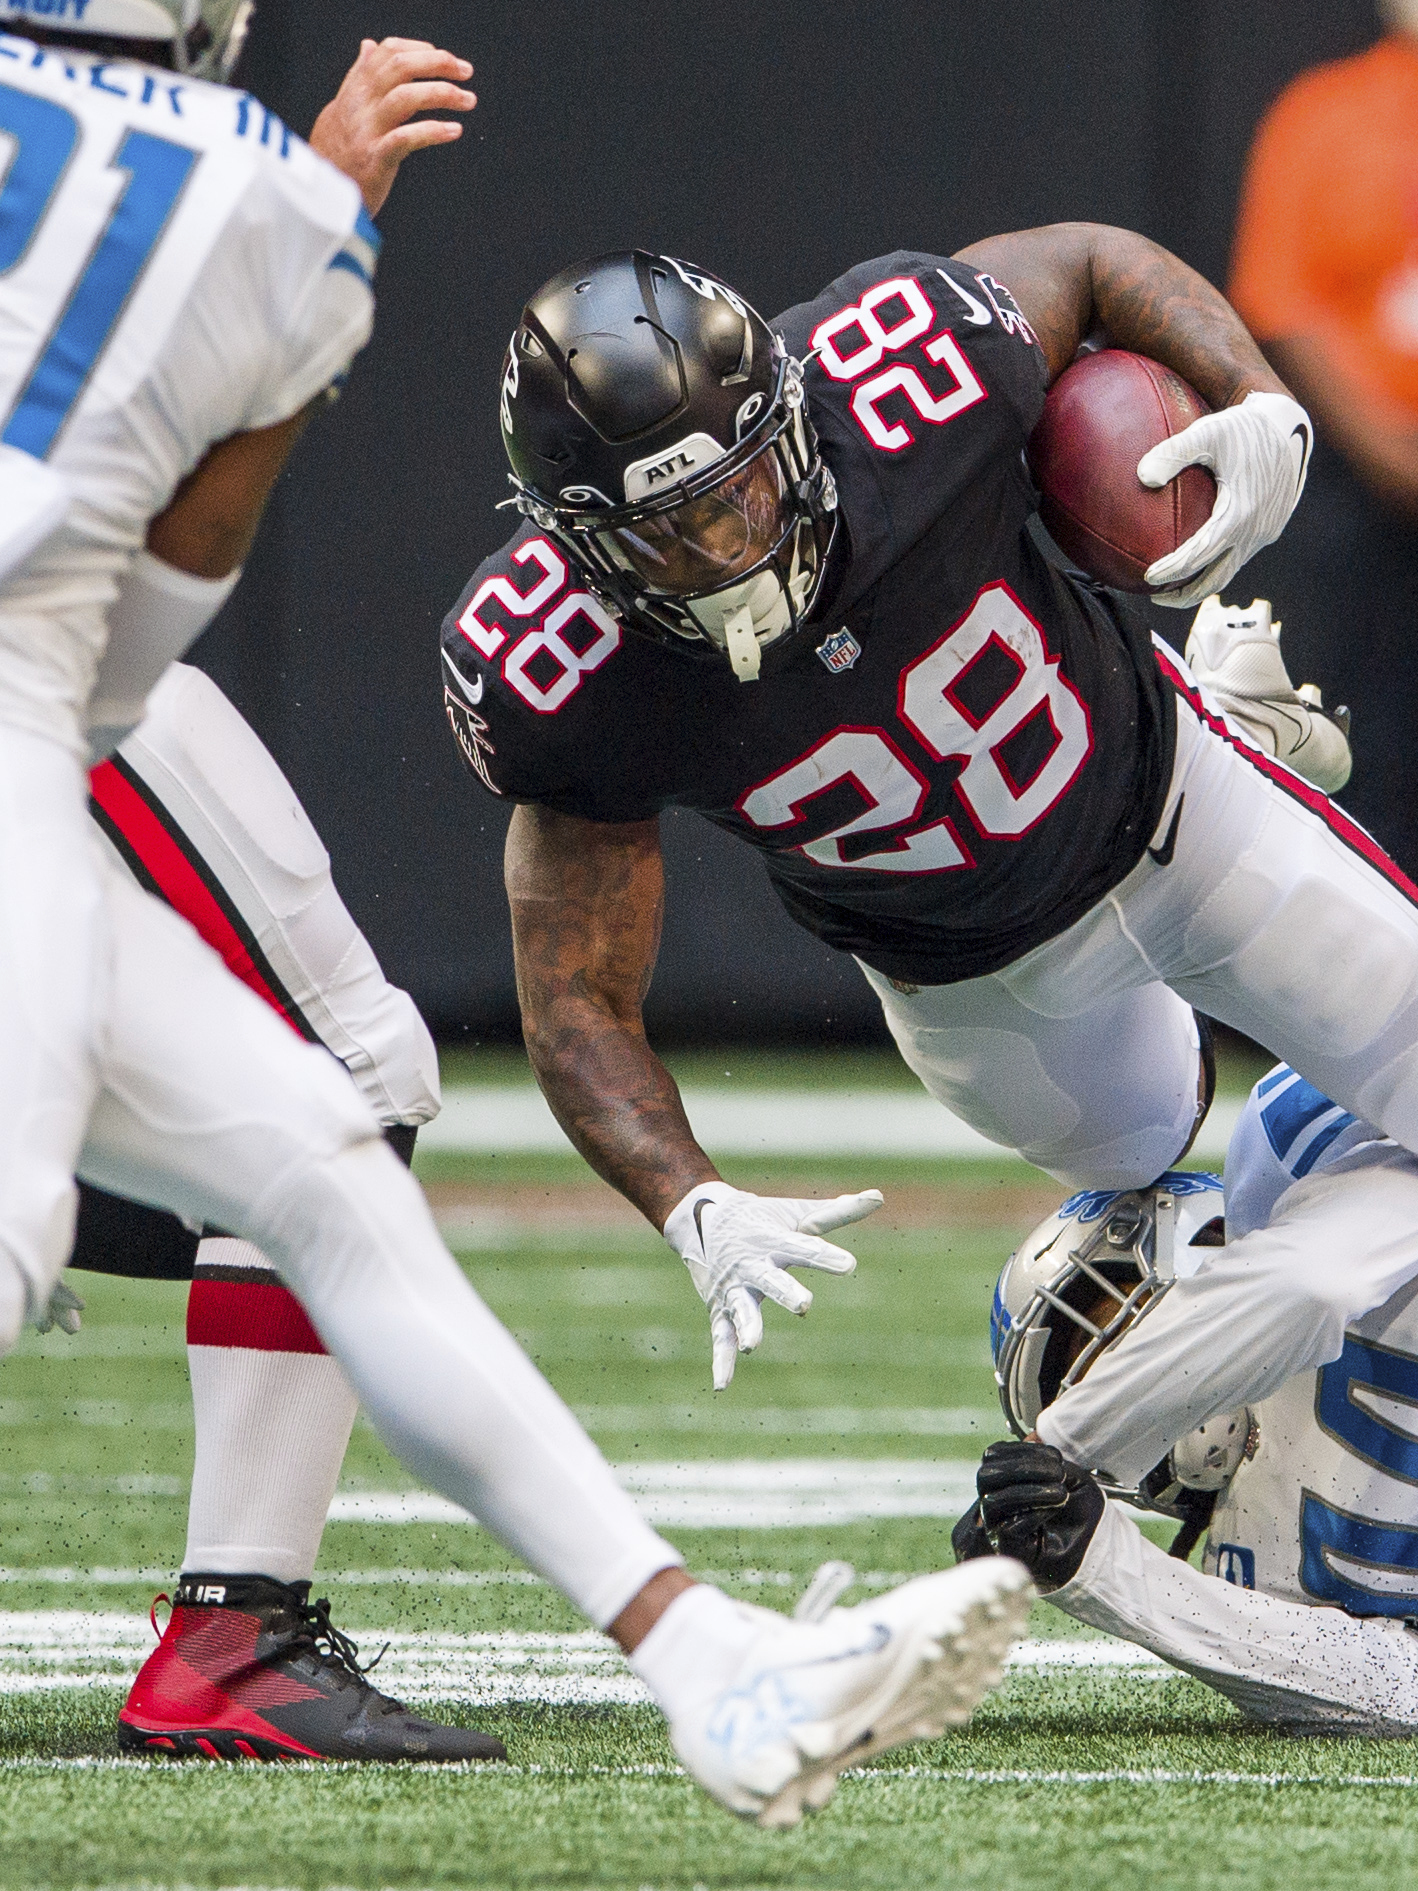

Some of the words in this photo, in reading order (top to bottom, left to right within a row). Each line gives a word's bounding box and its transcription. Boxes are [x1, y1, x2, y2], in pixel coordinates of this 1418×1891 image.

[809, 276, 988, 452] 28
[644, 451, 696, 485] ATL
[457, 537, 621, 714] 28
[829, 644, 856, 667] NFL
[735, 579, 1094, 874] 28
